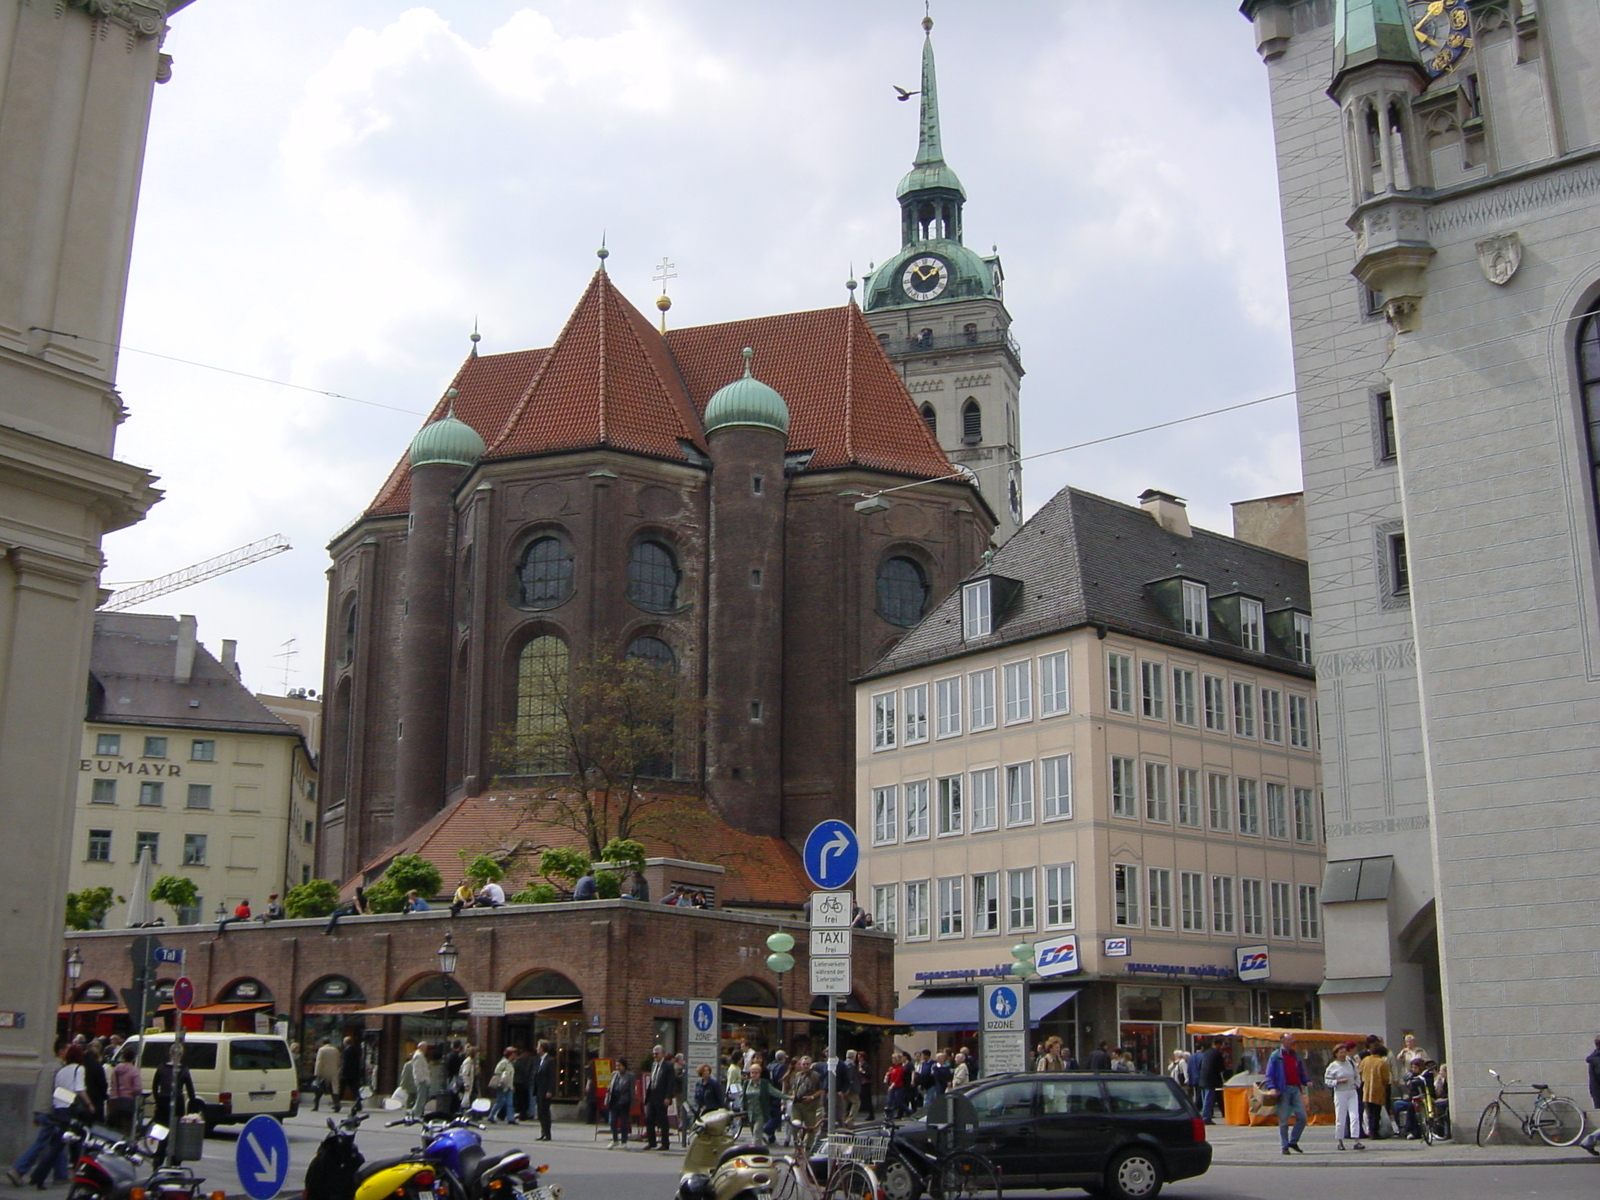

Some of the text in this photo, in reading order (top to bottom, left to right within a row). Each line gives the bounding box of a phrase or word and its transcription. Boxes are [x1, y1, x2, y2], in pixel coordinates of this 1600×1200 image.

[80, 760, 181, 777] EUMAYR
[824, 915, 838, 924] frei
[818, 932, 844, 944] TAXI
[1107, 941, 1125, 950] D2
[162, 949, 176, 961] Tal
[1037, 944, 1075, 968] D2
[1239, 953, 1269, 972] D2
[994, 1021, 1015, 1029] ZONE
